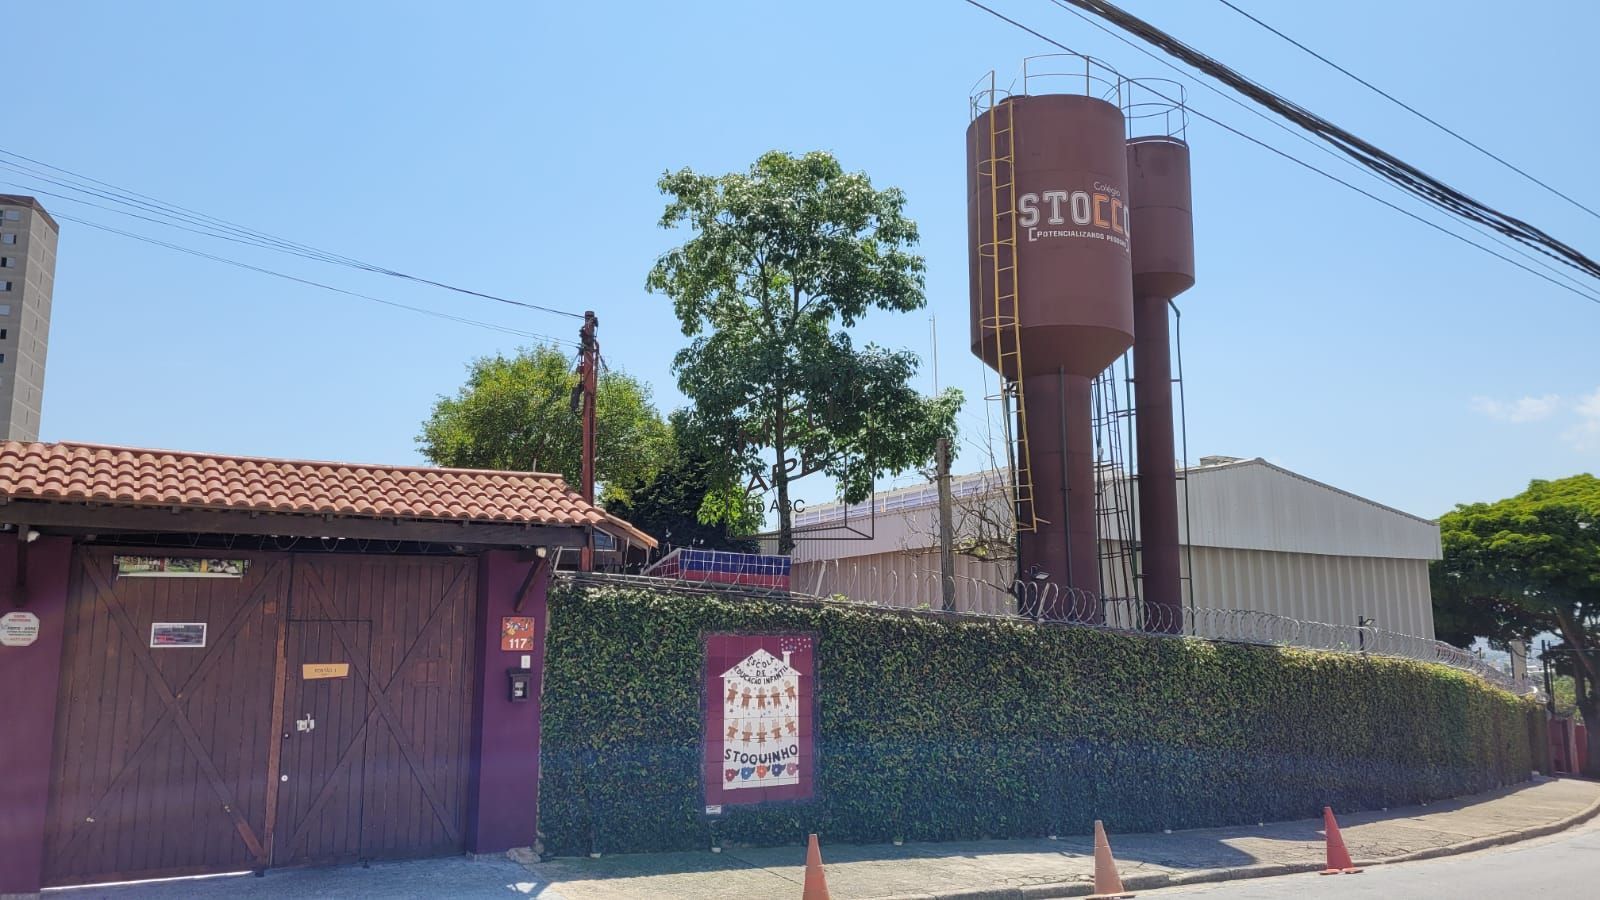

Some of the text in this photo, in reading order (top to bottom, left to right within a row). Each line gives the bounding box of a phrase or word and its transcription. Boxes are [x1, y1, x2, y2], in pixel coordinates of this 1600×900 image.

[1018, 190, 1130, 239] STOCCO
[509, 638, 528, 649] 117
[747, 656, 775, 669] ESCOLA
[756, 669, 767, 677] DE
[763, 665, 789, 685] INFANTIL
[724, 744, 799, 765] STOQUINHO
